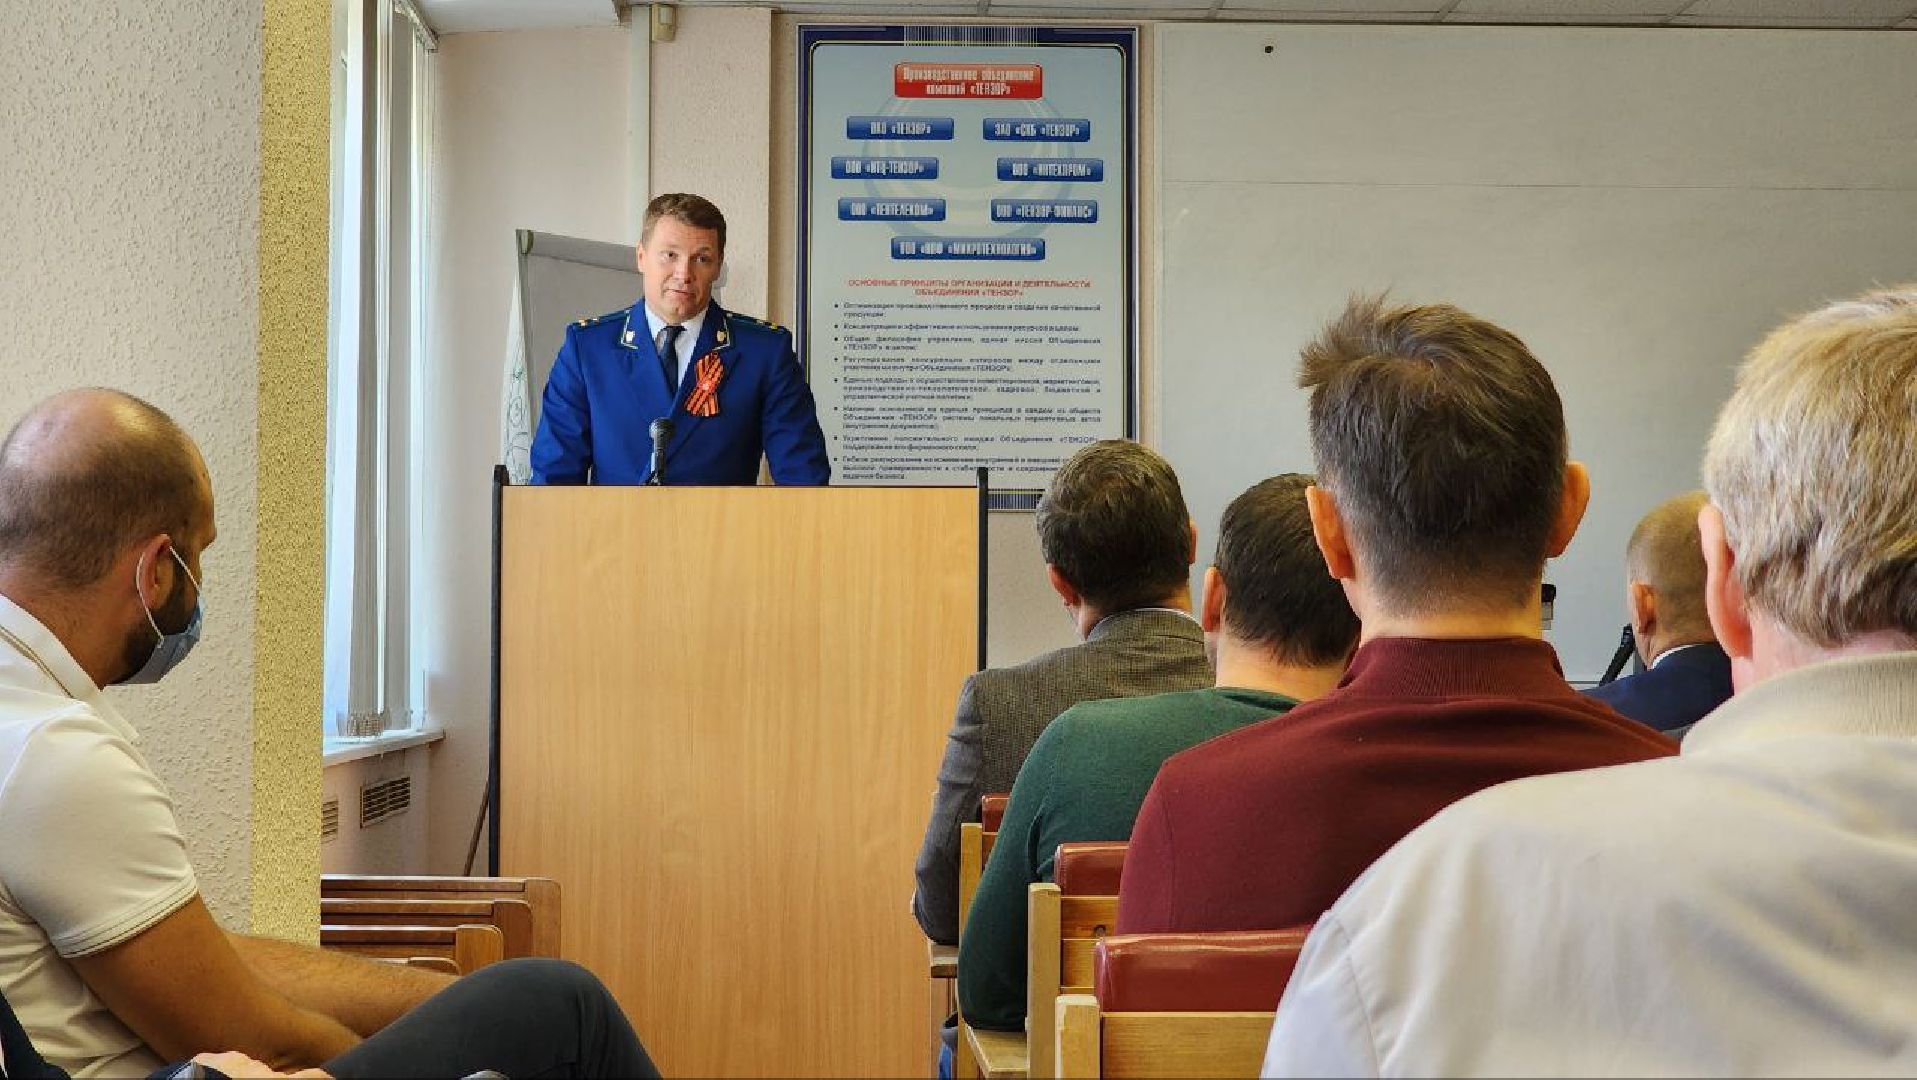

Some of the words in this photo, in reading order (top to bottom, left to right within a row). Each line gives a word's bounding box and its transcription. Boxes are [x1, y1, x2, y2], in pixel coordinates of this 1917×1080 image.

[903, 66, 977, 82] Производственное
[970, 83, 1010, 95] «ТЕНЗОР»
[1040, 123, 1080, 136] «ТЕНЗОР»
